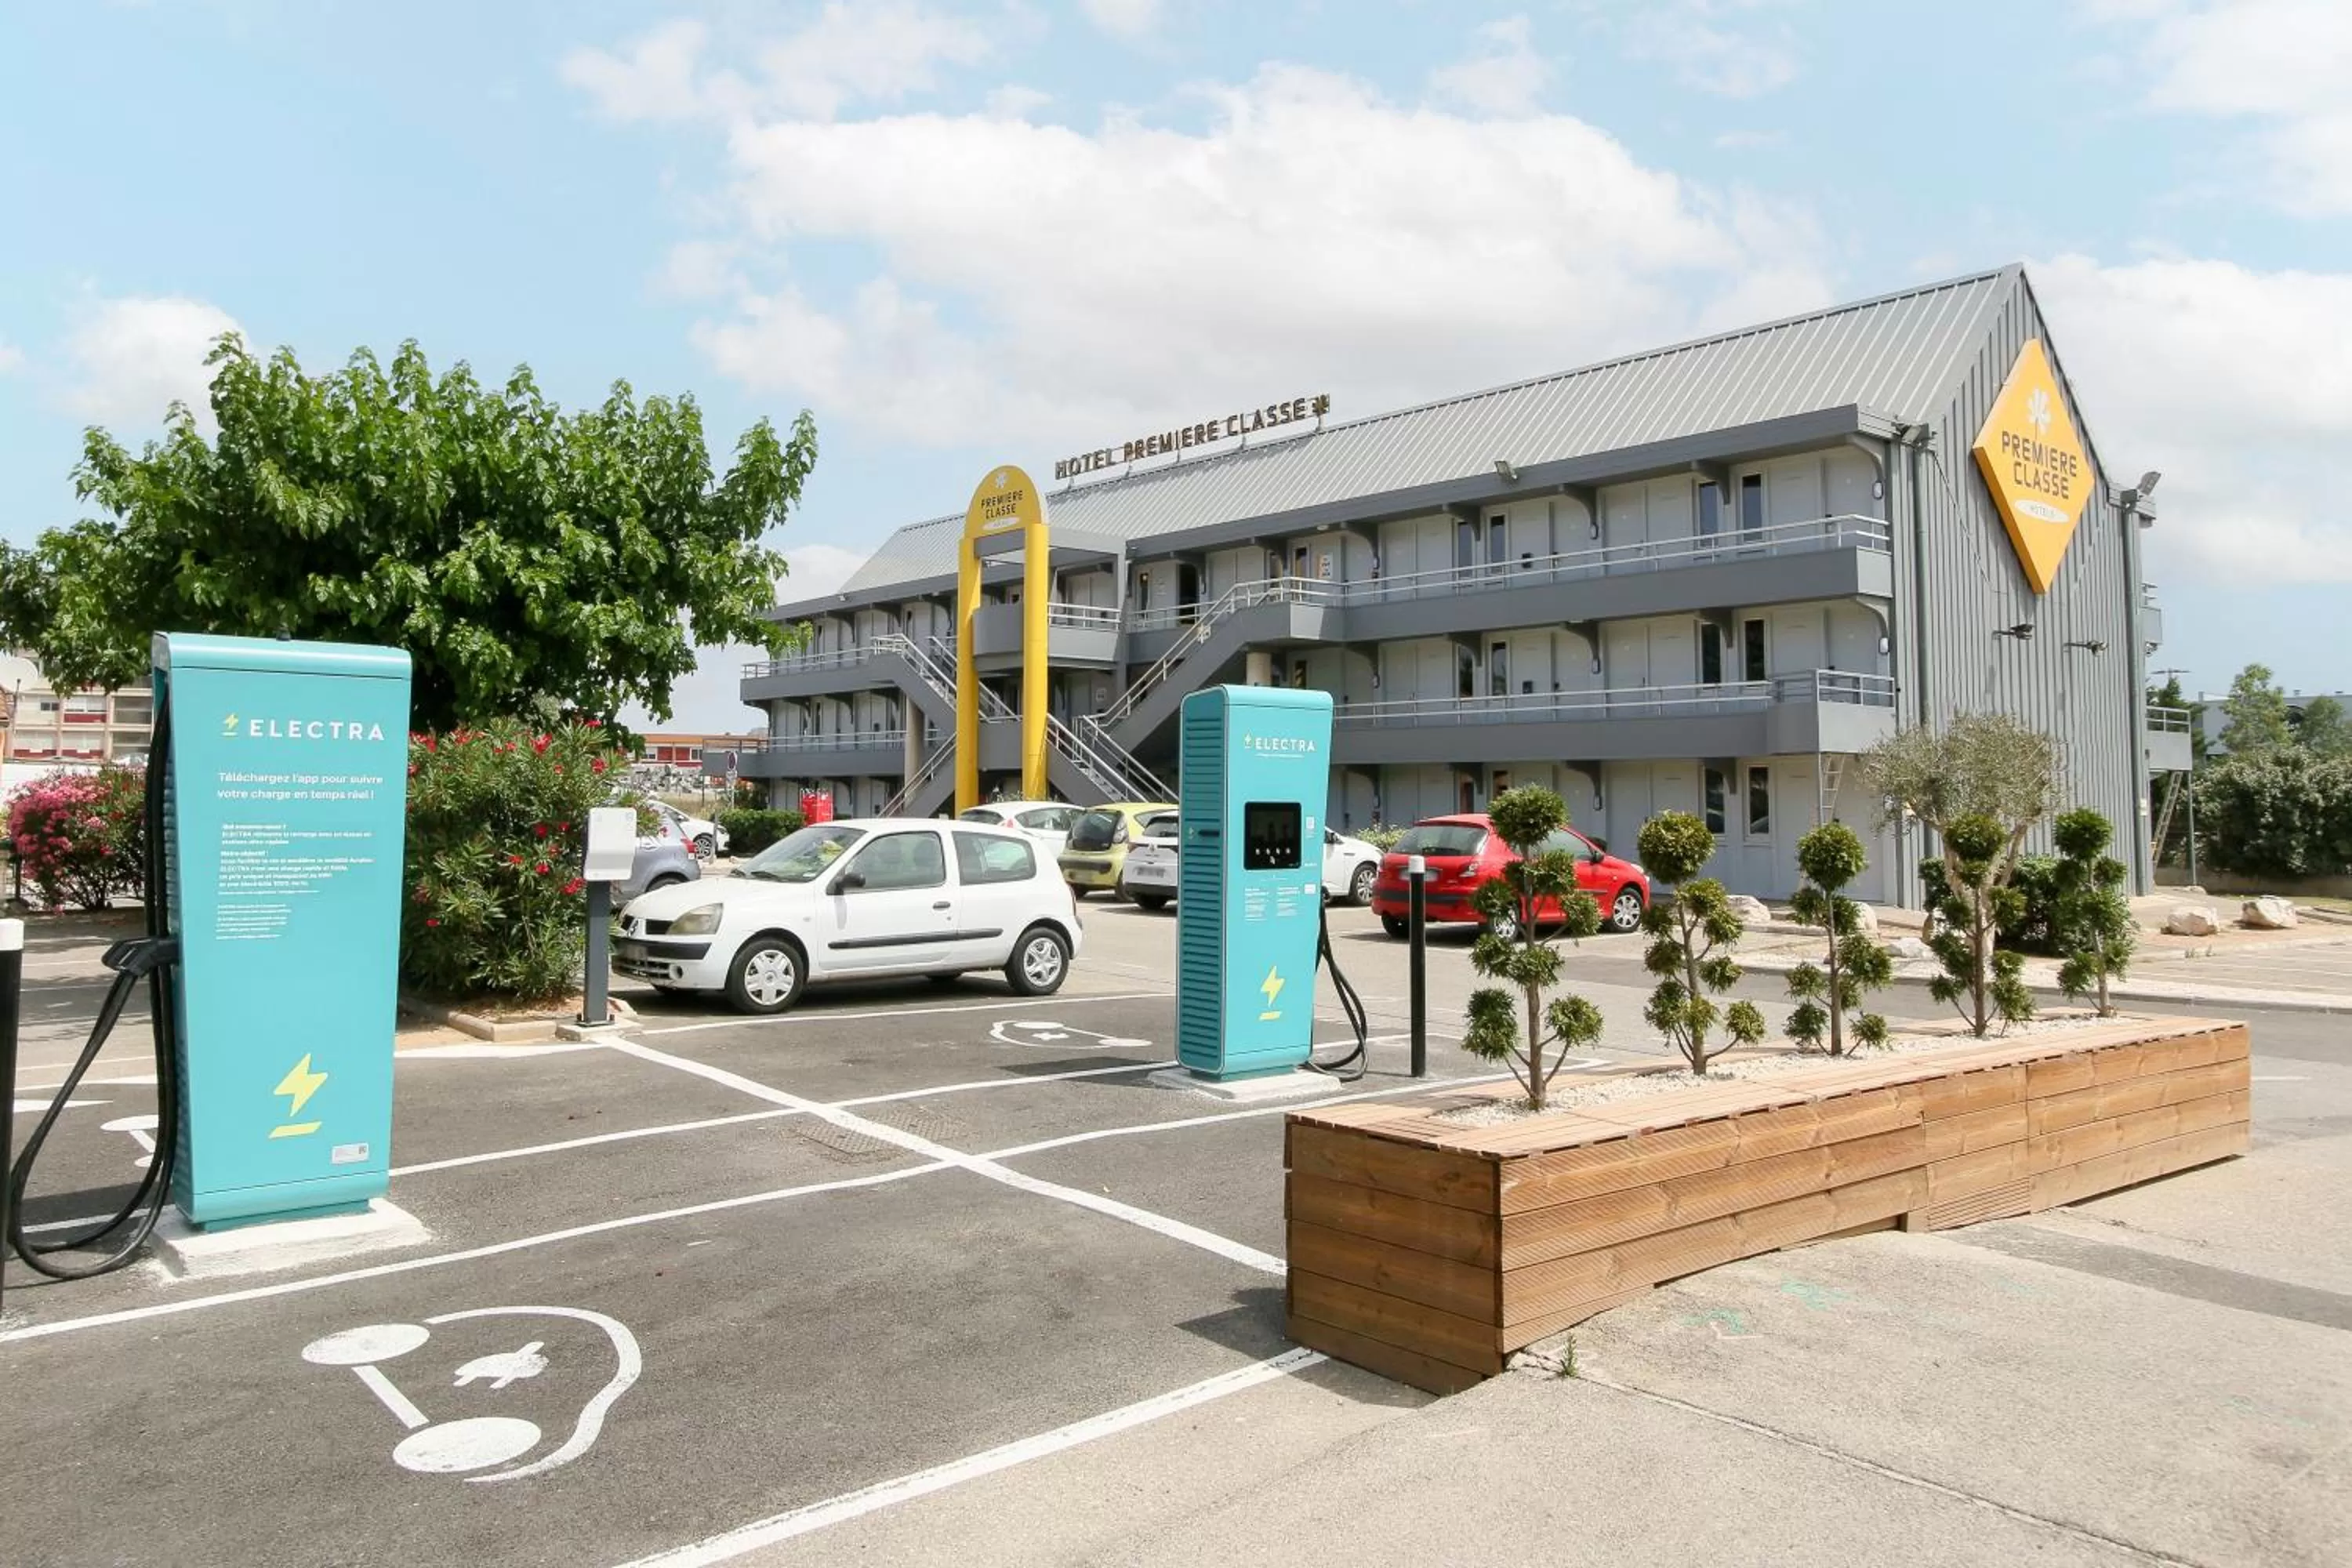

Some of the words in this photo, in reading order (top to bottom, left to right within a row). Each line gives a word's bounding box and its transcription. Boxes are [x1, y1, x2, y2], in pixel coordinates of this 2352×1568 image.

[1055, 448, 1116, 480] HOTEL
[1123, 419, 1220, 462] PREMIERE
[1227, 397, 1305, 436] CLASSE
[2002, 430, 2078, 477] PREMIERE
[2013, 462, 2069, 499] CLASSE
[981, 490, 1023, 509] PREMIERE
[985, 503, 1017, 520] CLASSE
[250, 719, 384, 741] ELECTRA
[1254, 738, 1316, 752] ELECTRA
[218, 771, 289, 784] Téléchargez
[292, 773, 319, 785] l'app
[321, 775, 347, 785] pour
[350, 774, 383, 783] suivre
[217, 789, 249, 799] votre
[251, 789, 291, 800] charge
[311, 790, 346, 801] temps
